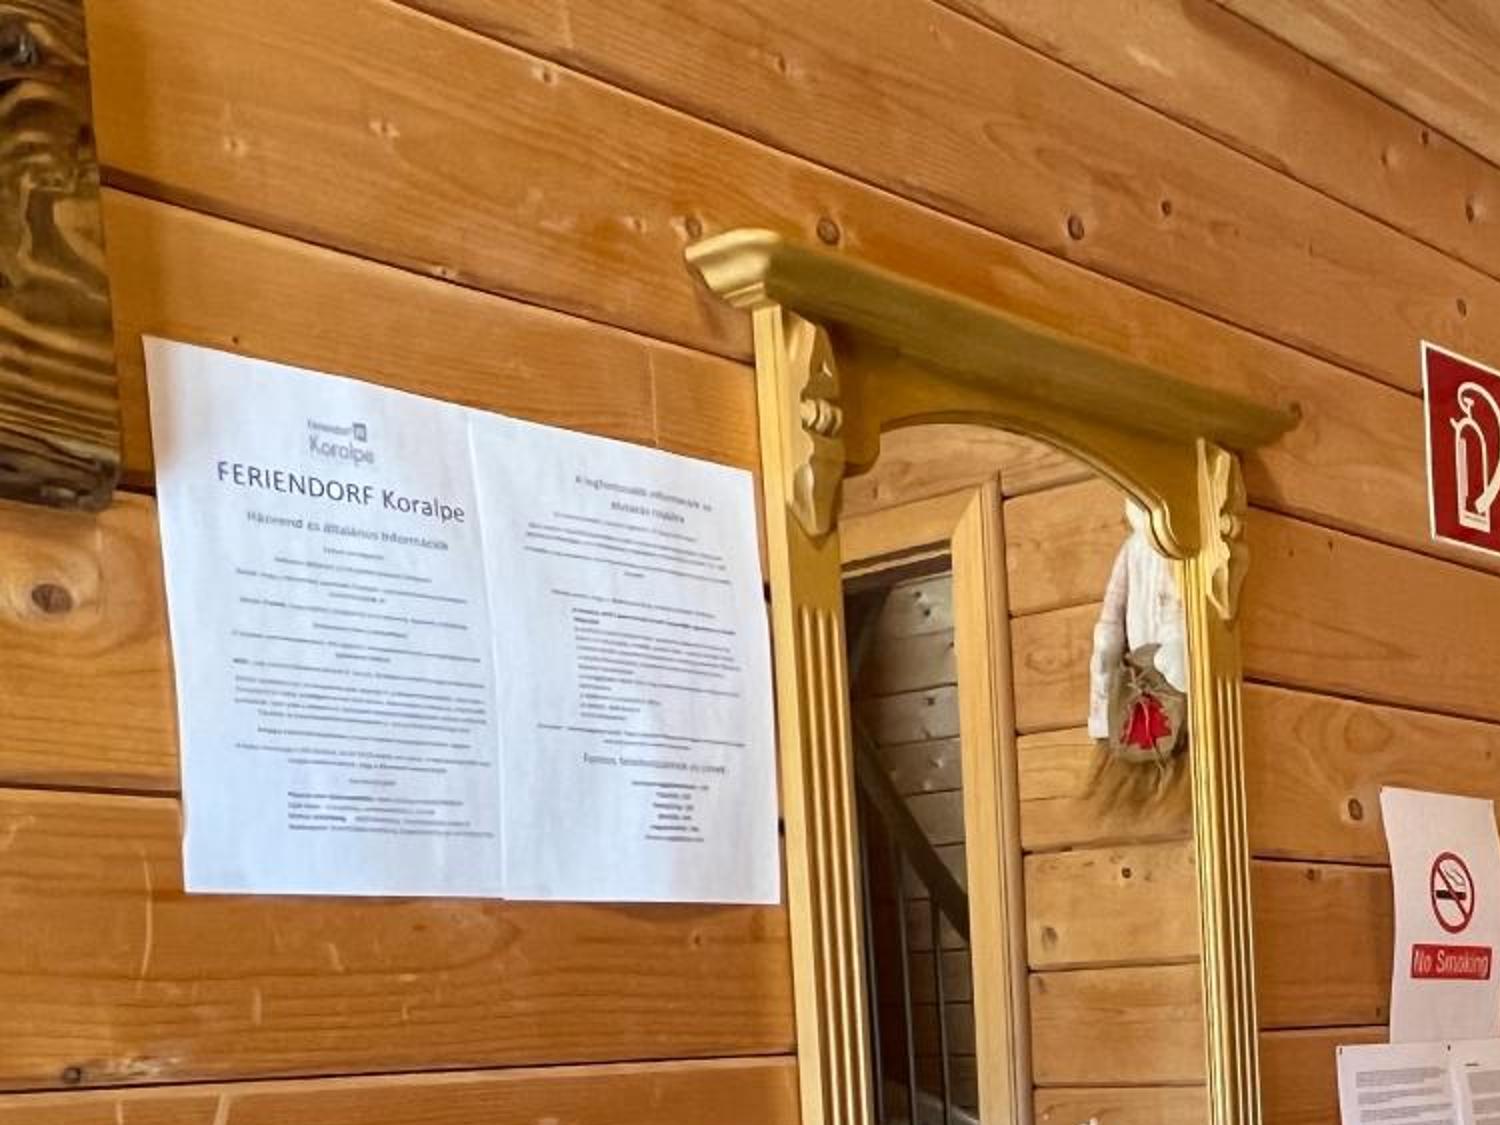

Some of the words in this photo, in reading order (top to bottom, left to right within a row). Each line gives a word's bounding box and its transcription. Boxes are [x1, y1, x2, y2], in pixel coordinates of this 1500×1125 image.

[308, 435, 375, 467] Koralpe
[217, 460, 375, 505] FERIENDORF
[381, 488, 466, 524] Koralpe
[1413, 949, 1433, 974] No
[1435, 949, 1489, 977] Smoking
